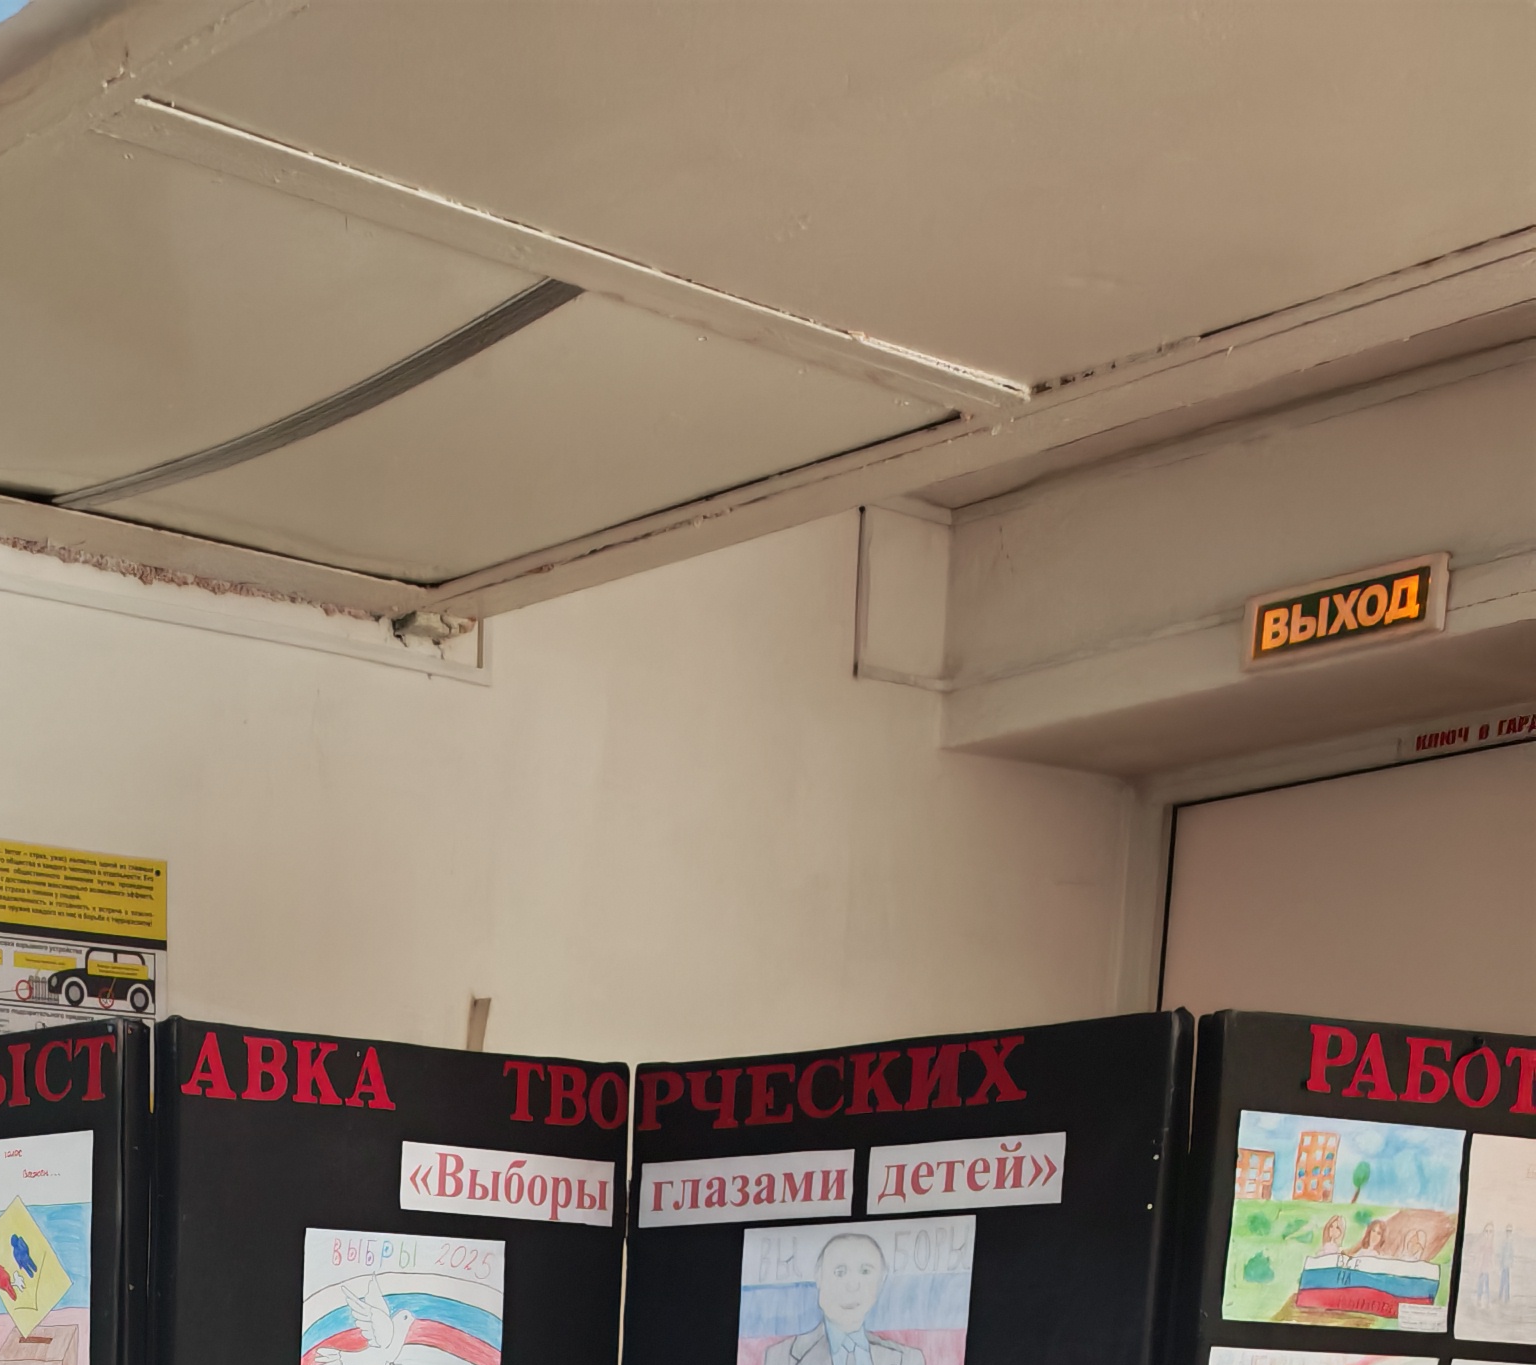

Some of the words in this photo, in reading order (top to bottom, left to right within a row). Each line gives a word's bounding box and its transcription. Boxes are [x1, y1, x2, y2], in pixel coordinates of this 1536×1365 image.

[1261, 575, 1420, 650] ВЫХОД
[1416, 726, 1469, 751] КЛЮЧ
[409, 1152, 609, 1221] «Выборы
[649, 1170, 849, 1212] глазами
[877, 1149, 1058, 1200] детей»
[435, 1242, 496, 1280] 2025
